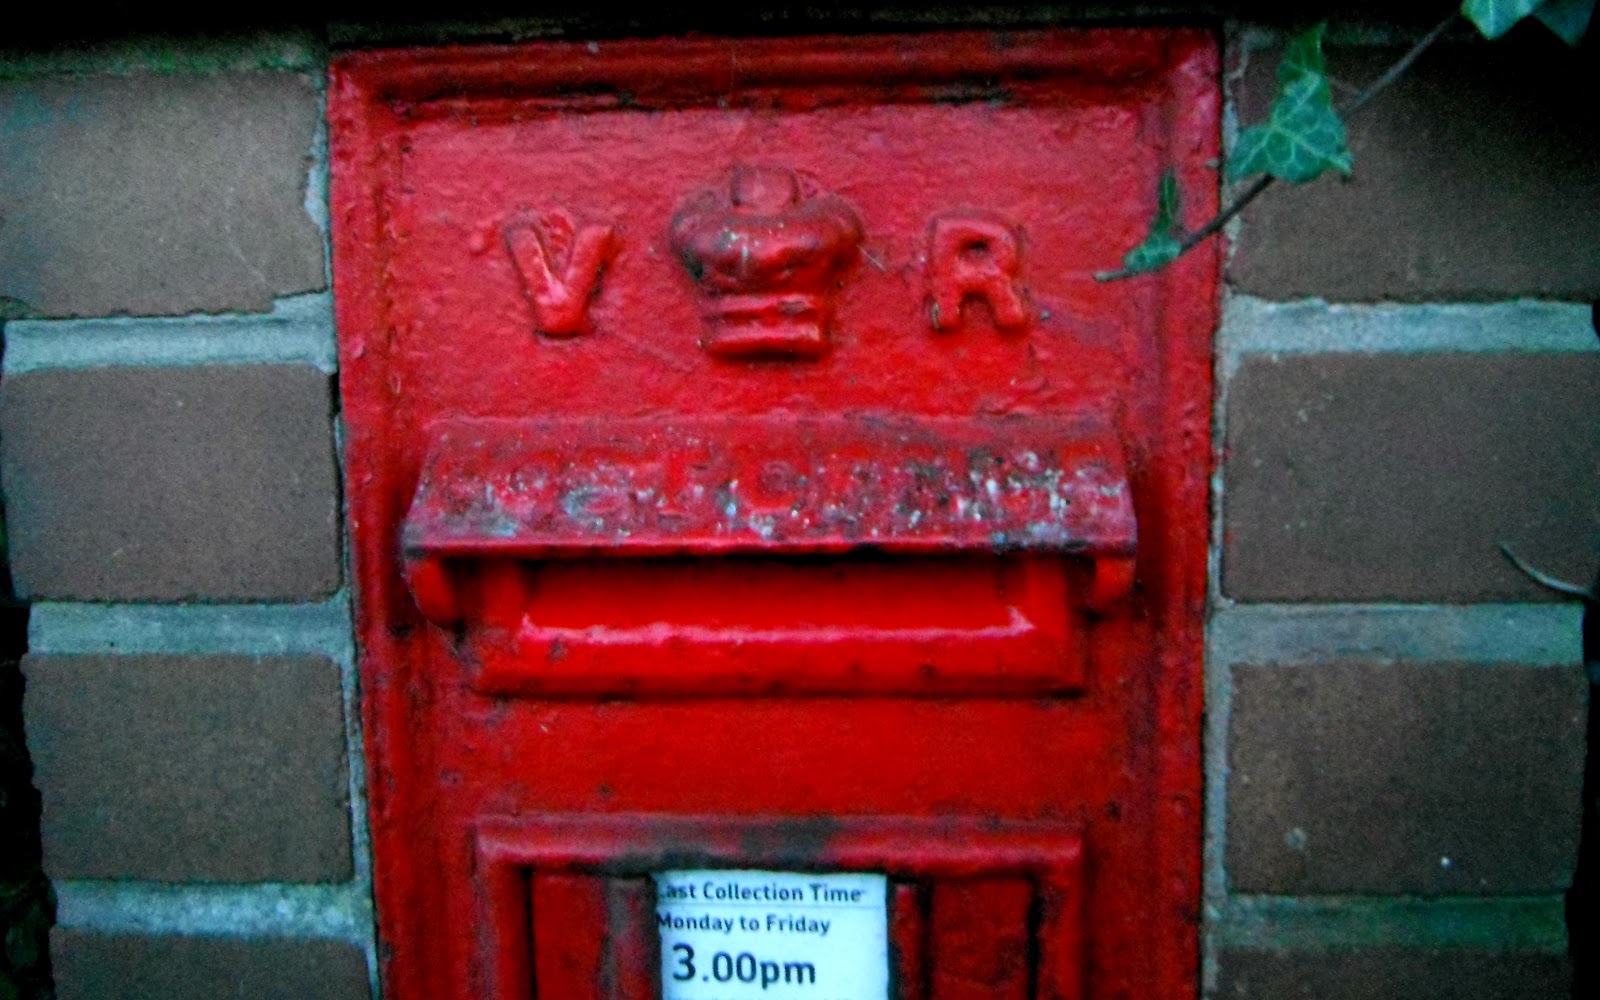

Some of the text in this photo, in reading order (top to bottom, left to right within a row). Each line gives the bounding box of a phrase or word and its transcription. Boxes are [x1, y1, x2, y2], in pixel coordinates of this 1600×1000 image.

[503, 209, 1029, 337] V R
[703, 880, 804, 901] Collection
[654, 911, 831, 936] Monday to Friday
[673, 943, 815, 989] 3.00pm
